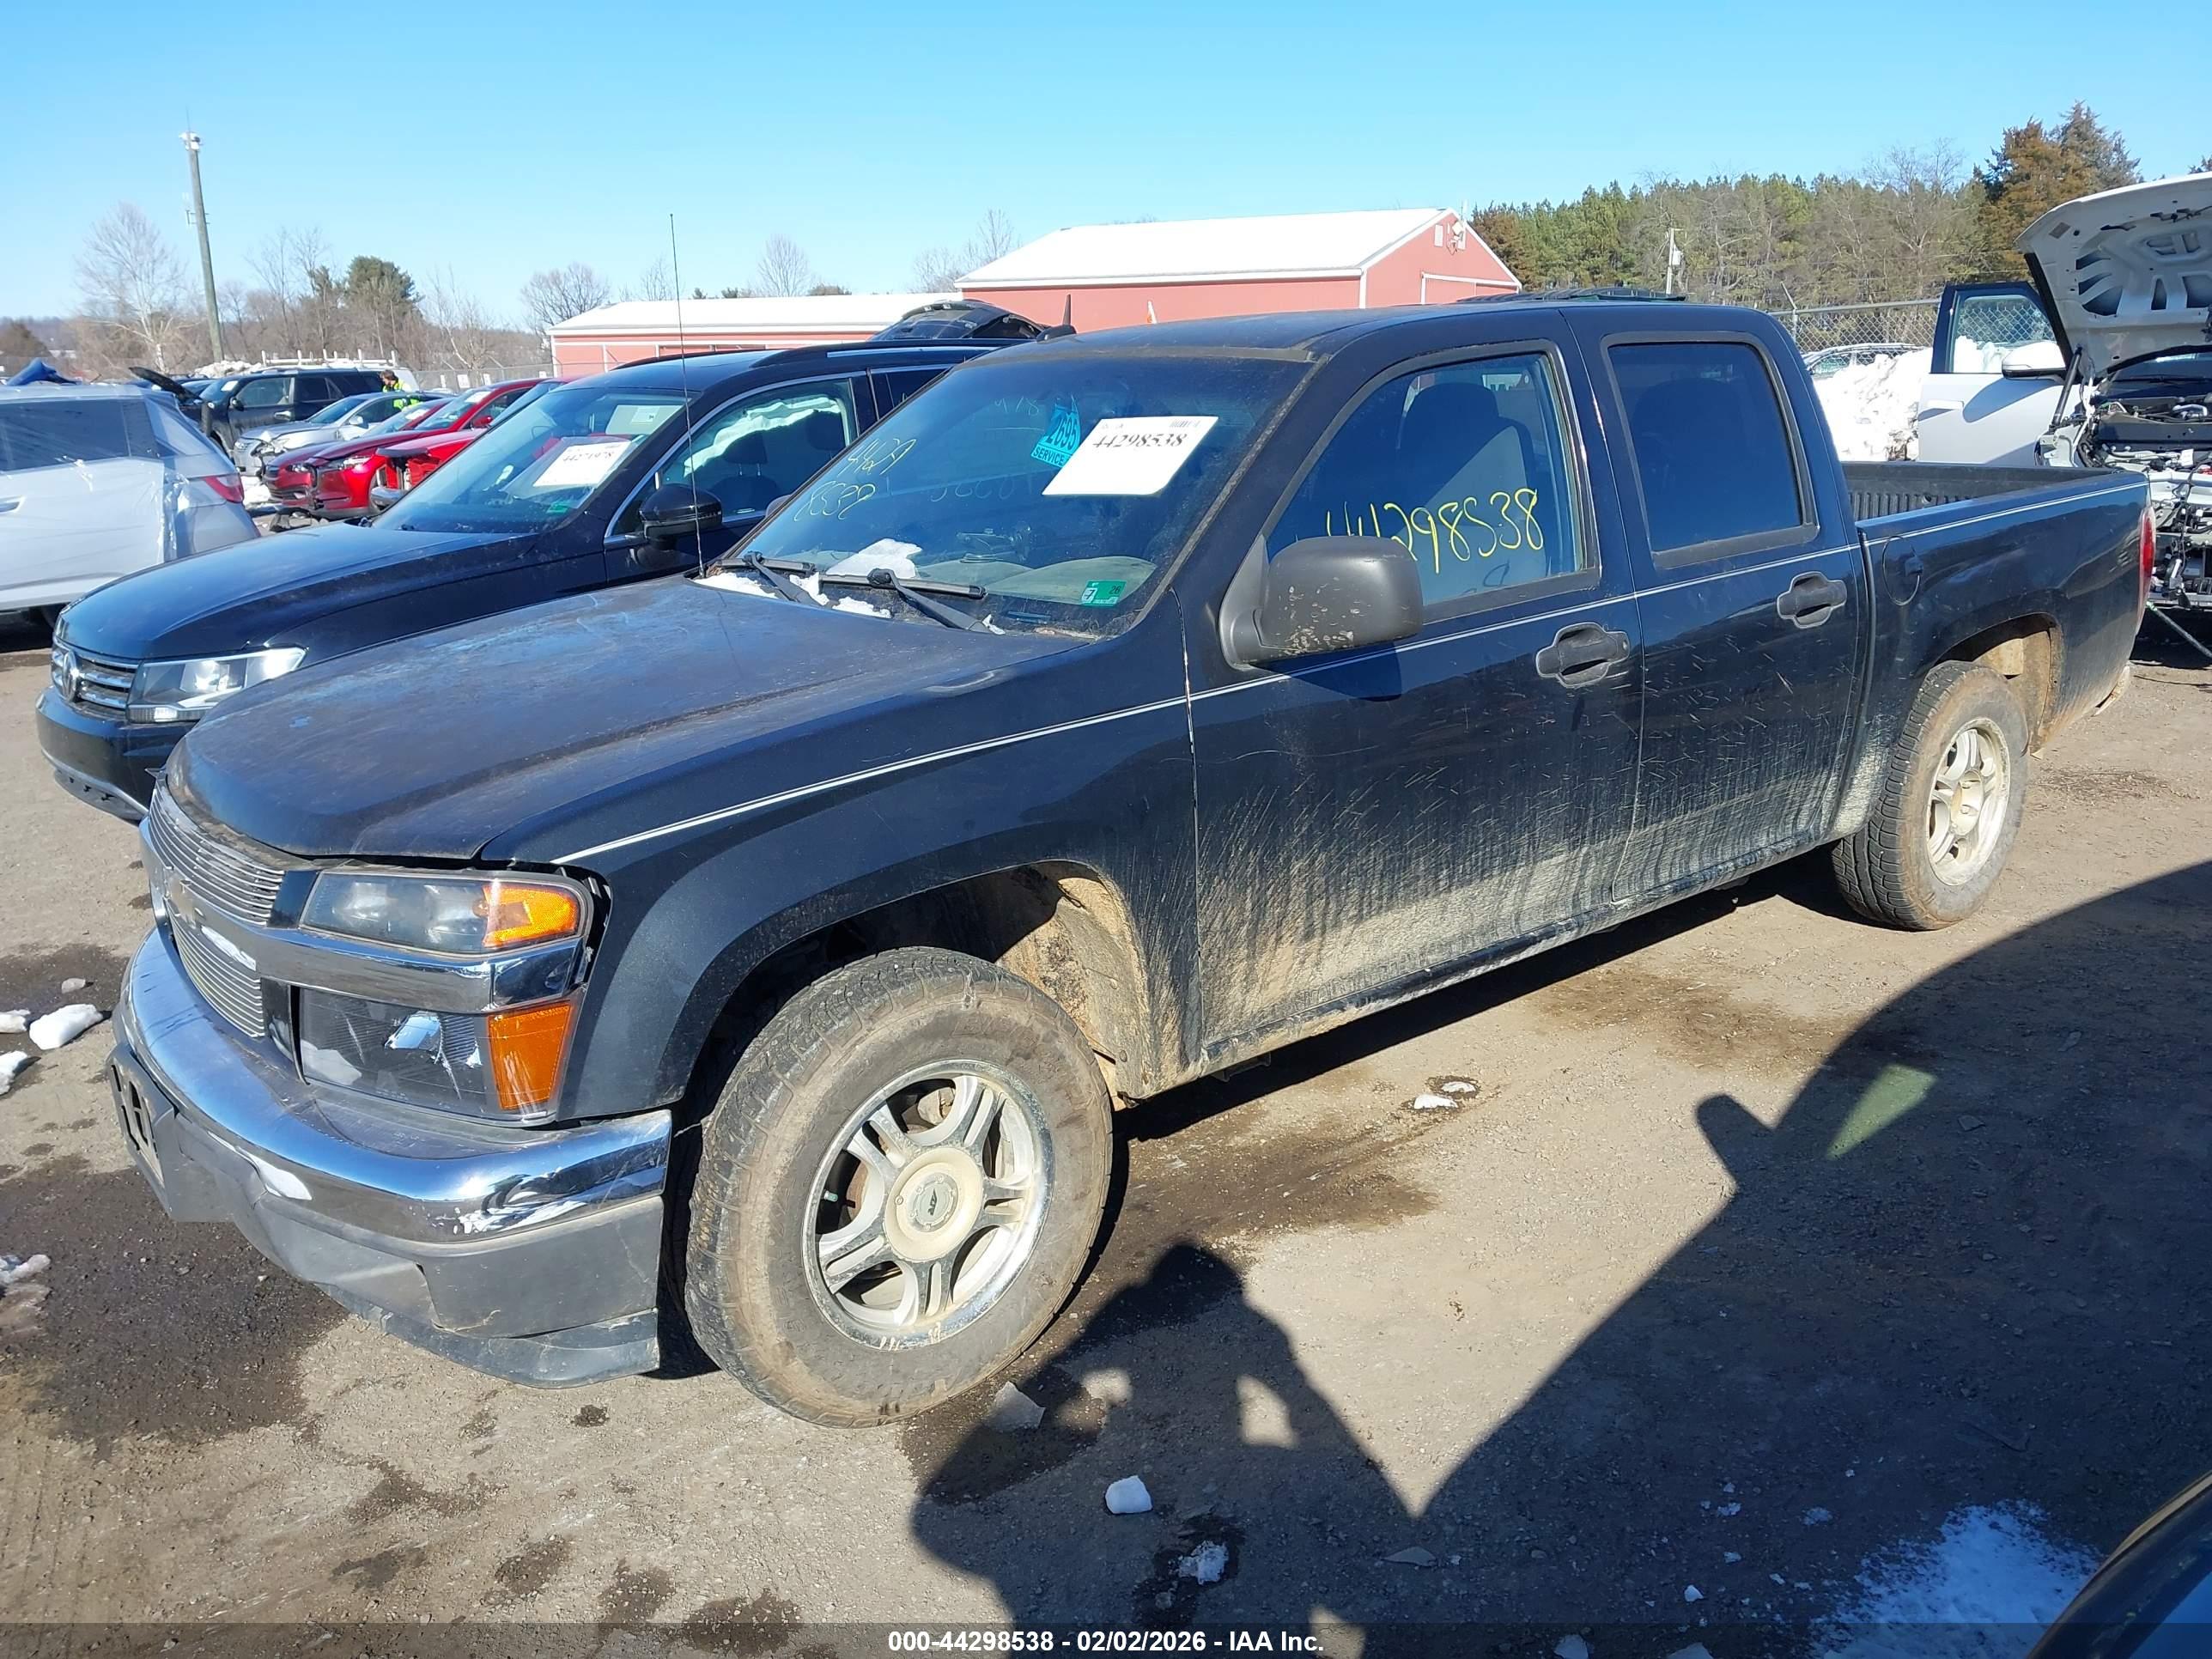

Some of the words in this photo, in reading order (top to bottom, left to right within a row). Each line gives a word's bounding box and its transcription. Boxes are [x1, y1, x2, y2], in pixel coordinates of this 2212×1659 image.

[1045, 416, 1077, 451] 2695
[1091, 432, 1188, 448] 44298538
[1033, 447, 1065, 466] SERVICE
